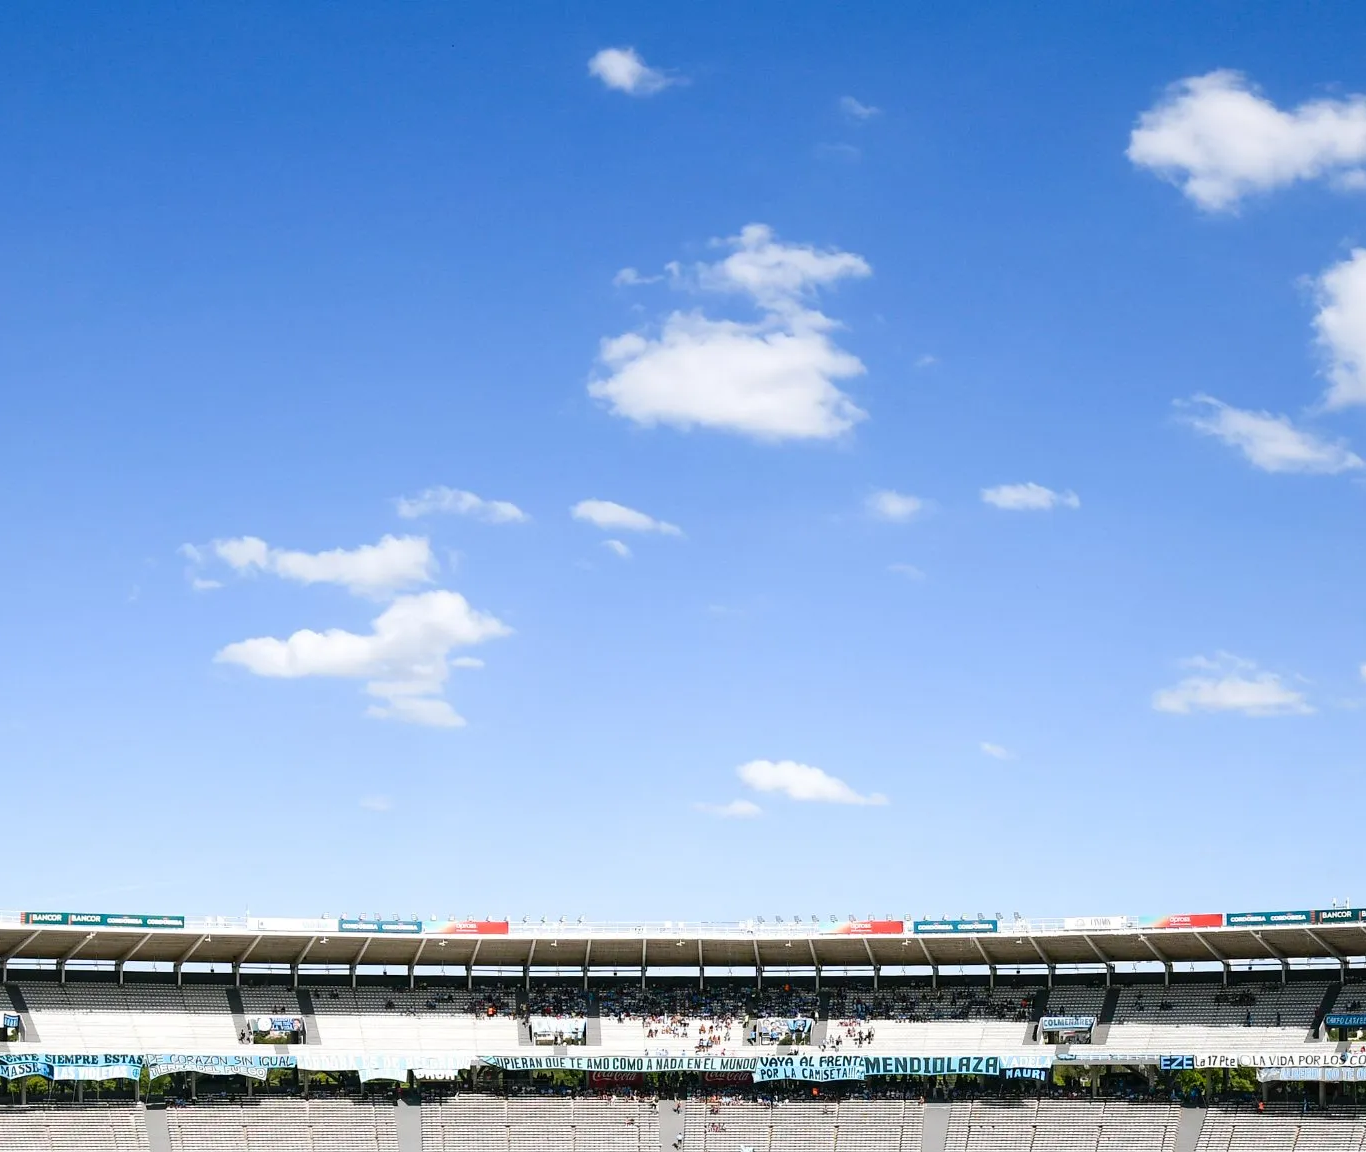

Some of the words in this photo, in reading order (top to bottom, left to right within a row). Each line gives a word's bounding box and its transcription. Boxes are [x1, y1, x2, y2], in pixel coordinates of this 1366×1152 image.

[32, 914, 62, 922] BANCOR
[71, 914, 101, 923] BANCOR
[1322, 910, 1353, 920] BANCOR
[1043, 1017, 1093, 1028] COLMENARES
[44, 1053, 99, 1065] SIEMPRE
[104, 1053, 143, 1065] ESTAS
[169, 1054, 228, 1066] CORAZON
[234, 1055, 254, 1066] SIN
[258, 1055, 294, 1067] IGUAL
[545, 1057, 566, 1070] QUE
[569, 1057, 583, 1070] TE
[586, 1058, 610, 1070] AMO
[612, 1058, 644, 1070] COMO
[646, 1058, 654, 1071] A
[656, 1058, 684, 1070] NADA
[687, 1058, 700, 1070] EN
[702, 1058, 717, 1070] EL
[720, 1057, 756, 1070] MUNDO
[760, 1056, 793, 1067] VAYA
[799, 1056, 815, 1067] AL
[1161, 1056, 1194, 1069] EZE
[1207, 1056, 1218, 1066] 17
[1219, 1056, 1236, 1067] Pte
[1252, 1055, 1266, 1066] LA
[1269, 1055, 1295, 1065] VIDA
[1298, 1055, 1321, 1066] POR
[864, 1057, 999, 1073] MENDIOLAZA
[760, 1069, 781, 1080] POR
[784, 1069, 797, 1079] LA
[1005, 1068, 1046, 1081] MAURI
